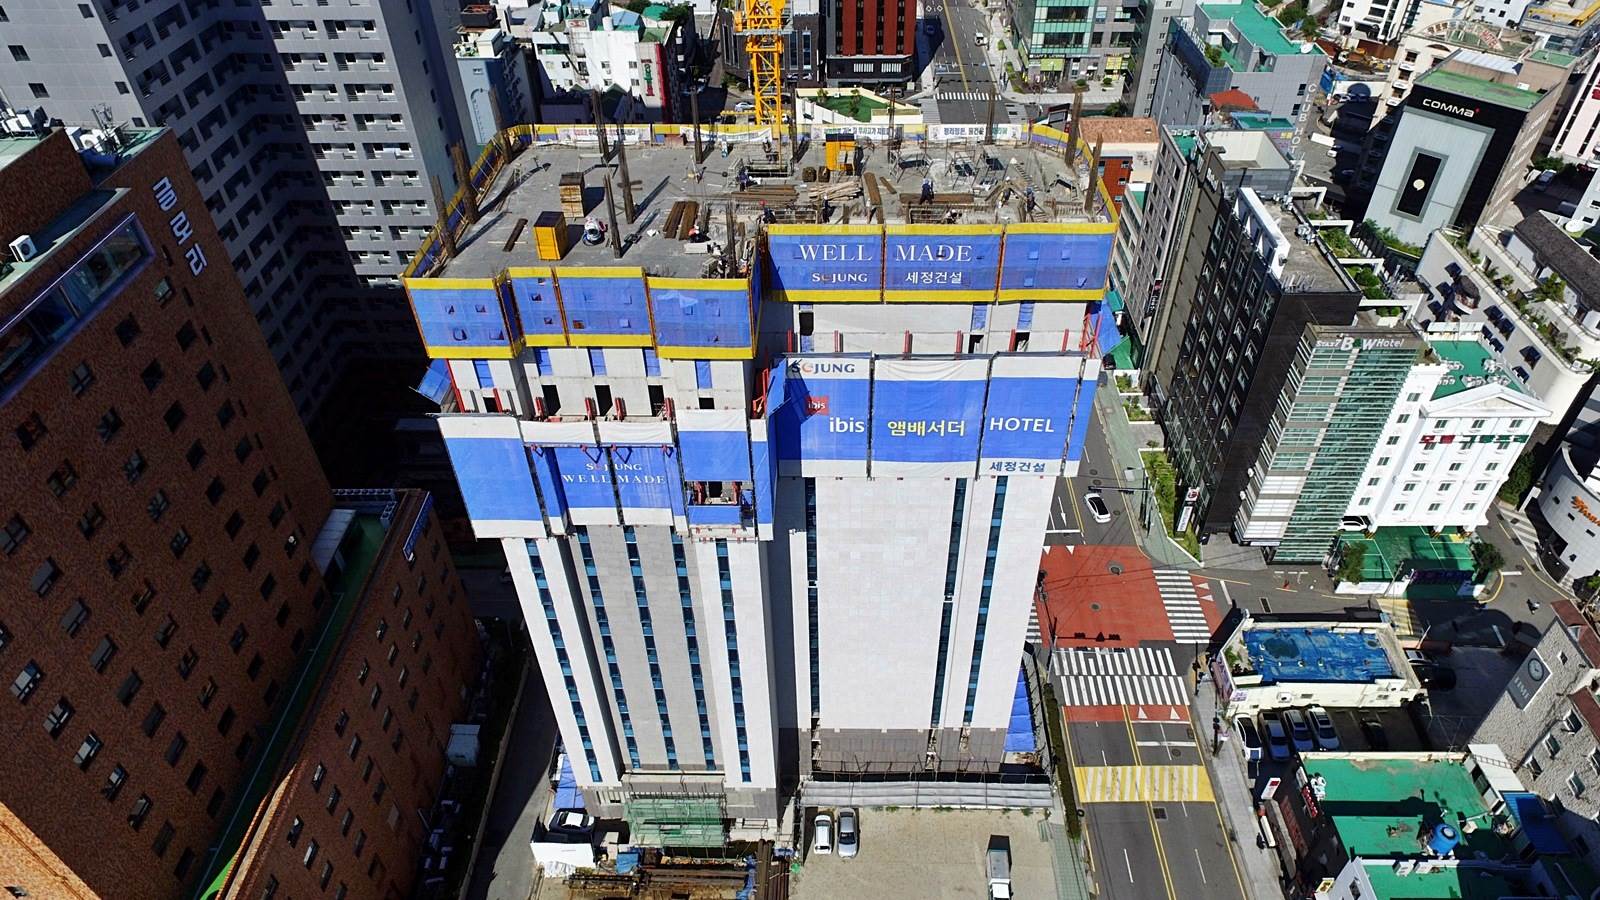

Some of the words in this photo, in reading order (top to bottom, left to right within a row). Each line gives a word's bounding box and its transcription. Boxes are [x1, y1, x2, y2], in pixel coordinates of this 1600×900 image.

[1299, 83, 1317, 122] CLUB
[799, 244, 873, 262] WELL
[896, 244, 972, 263] MADE
[905, 271, 964, 285] 세정건설
[1376, 338, 1404, 348] Hotel
[808, 401, 826, 410] ibis
[829, 417, 866, 434] ibis
[887, 421, 968, 438] 앰배서더
[990, 417, 1056, 434] HOTEL
[990, 461, 1047, 474] 세정건설
[617, 474, 665, 484] MADE
